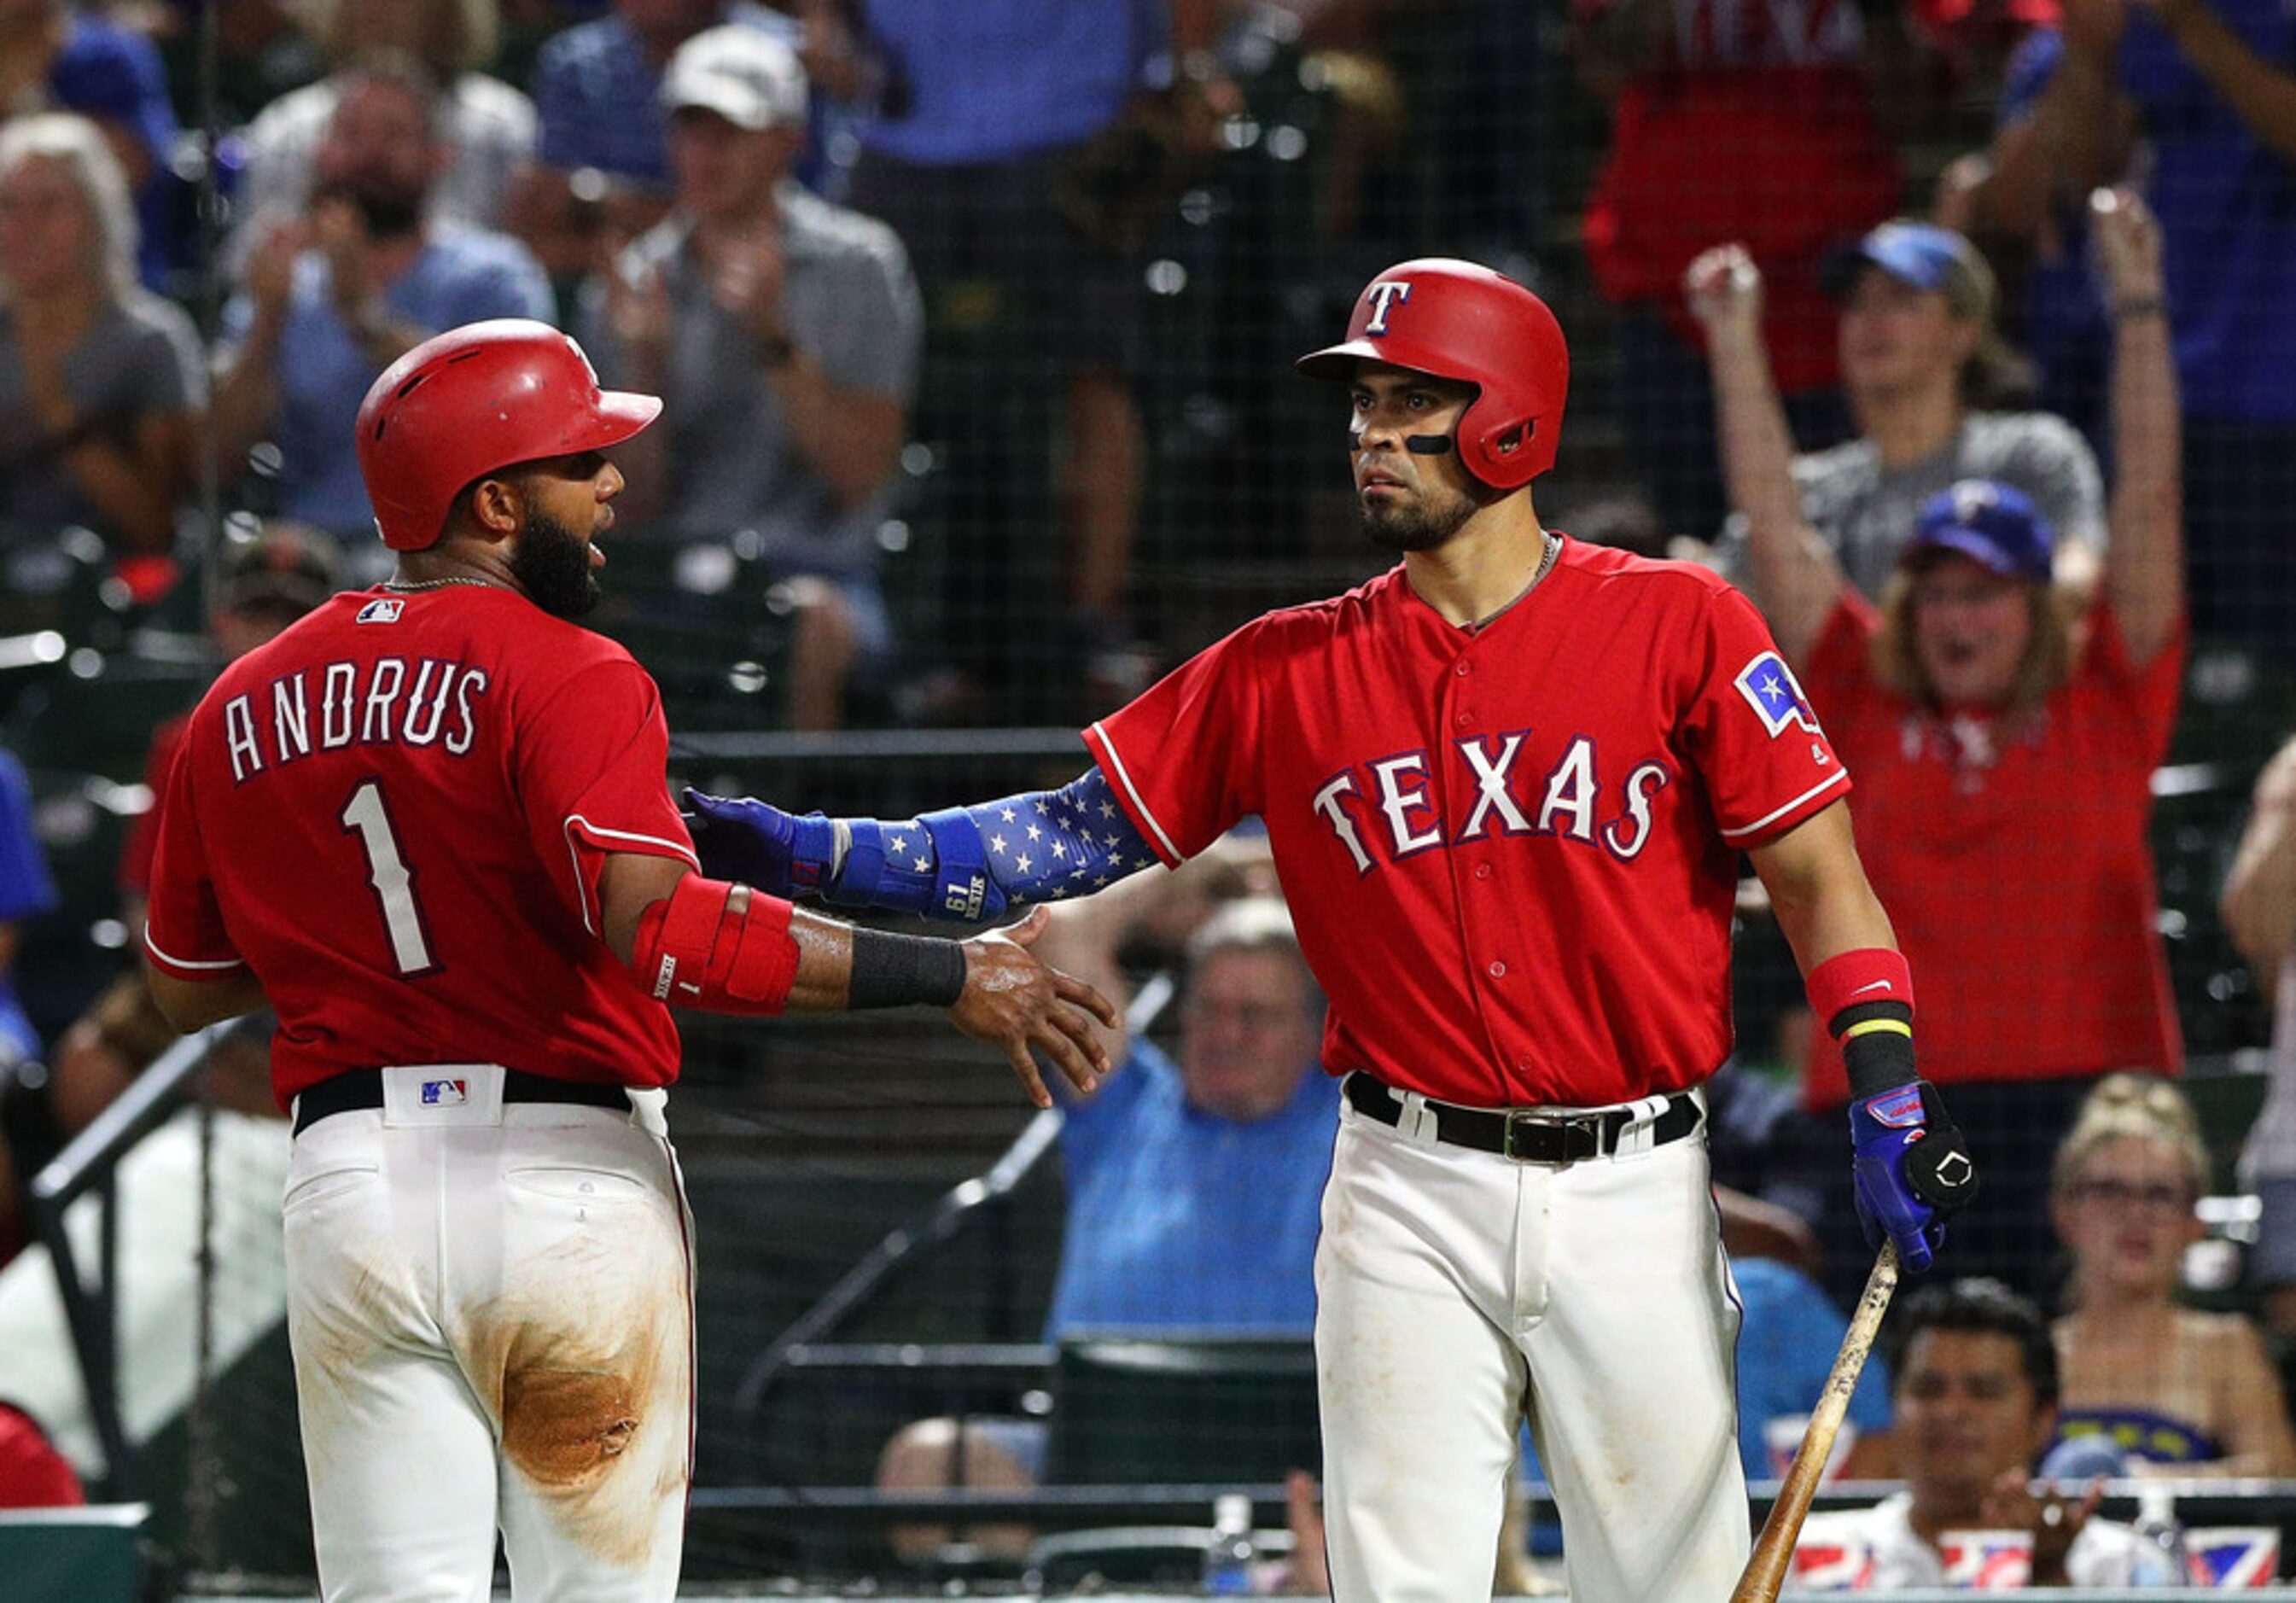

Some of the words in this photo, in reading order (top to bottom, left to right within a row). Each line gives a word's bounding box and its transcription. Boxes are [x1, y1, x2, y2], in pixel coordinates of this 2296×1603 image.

[1367, 282, 1413, 336] T
[224, 656, 488, 785] ANDRUS
[1312, 729, 1670, 877] TEXAS
[339, 778, 438, 977] 1
[946, 883, 969, 912] 61
